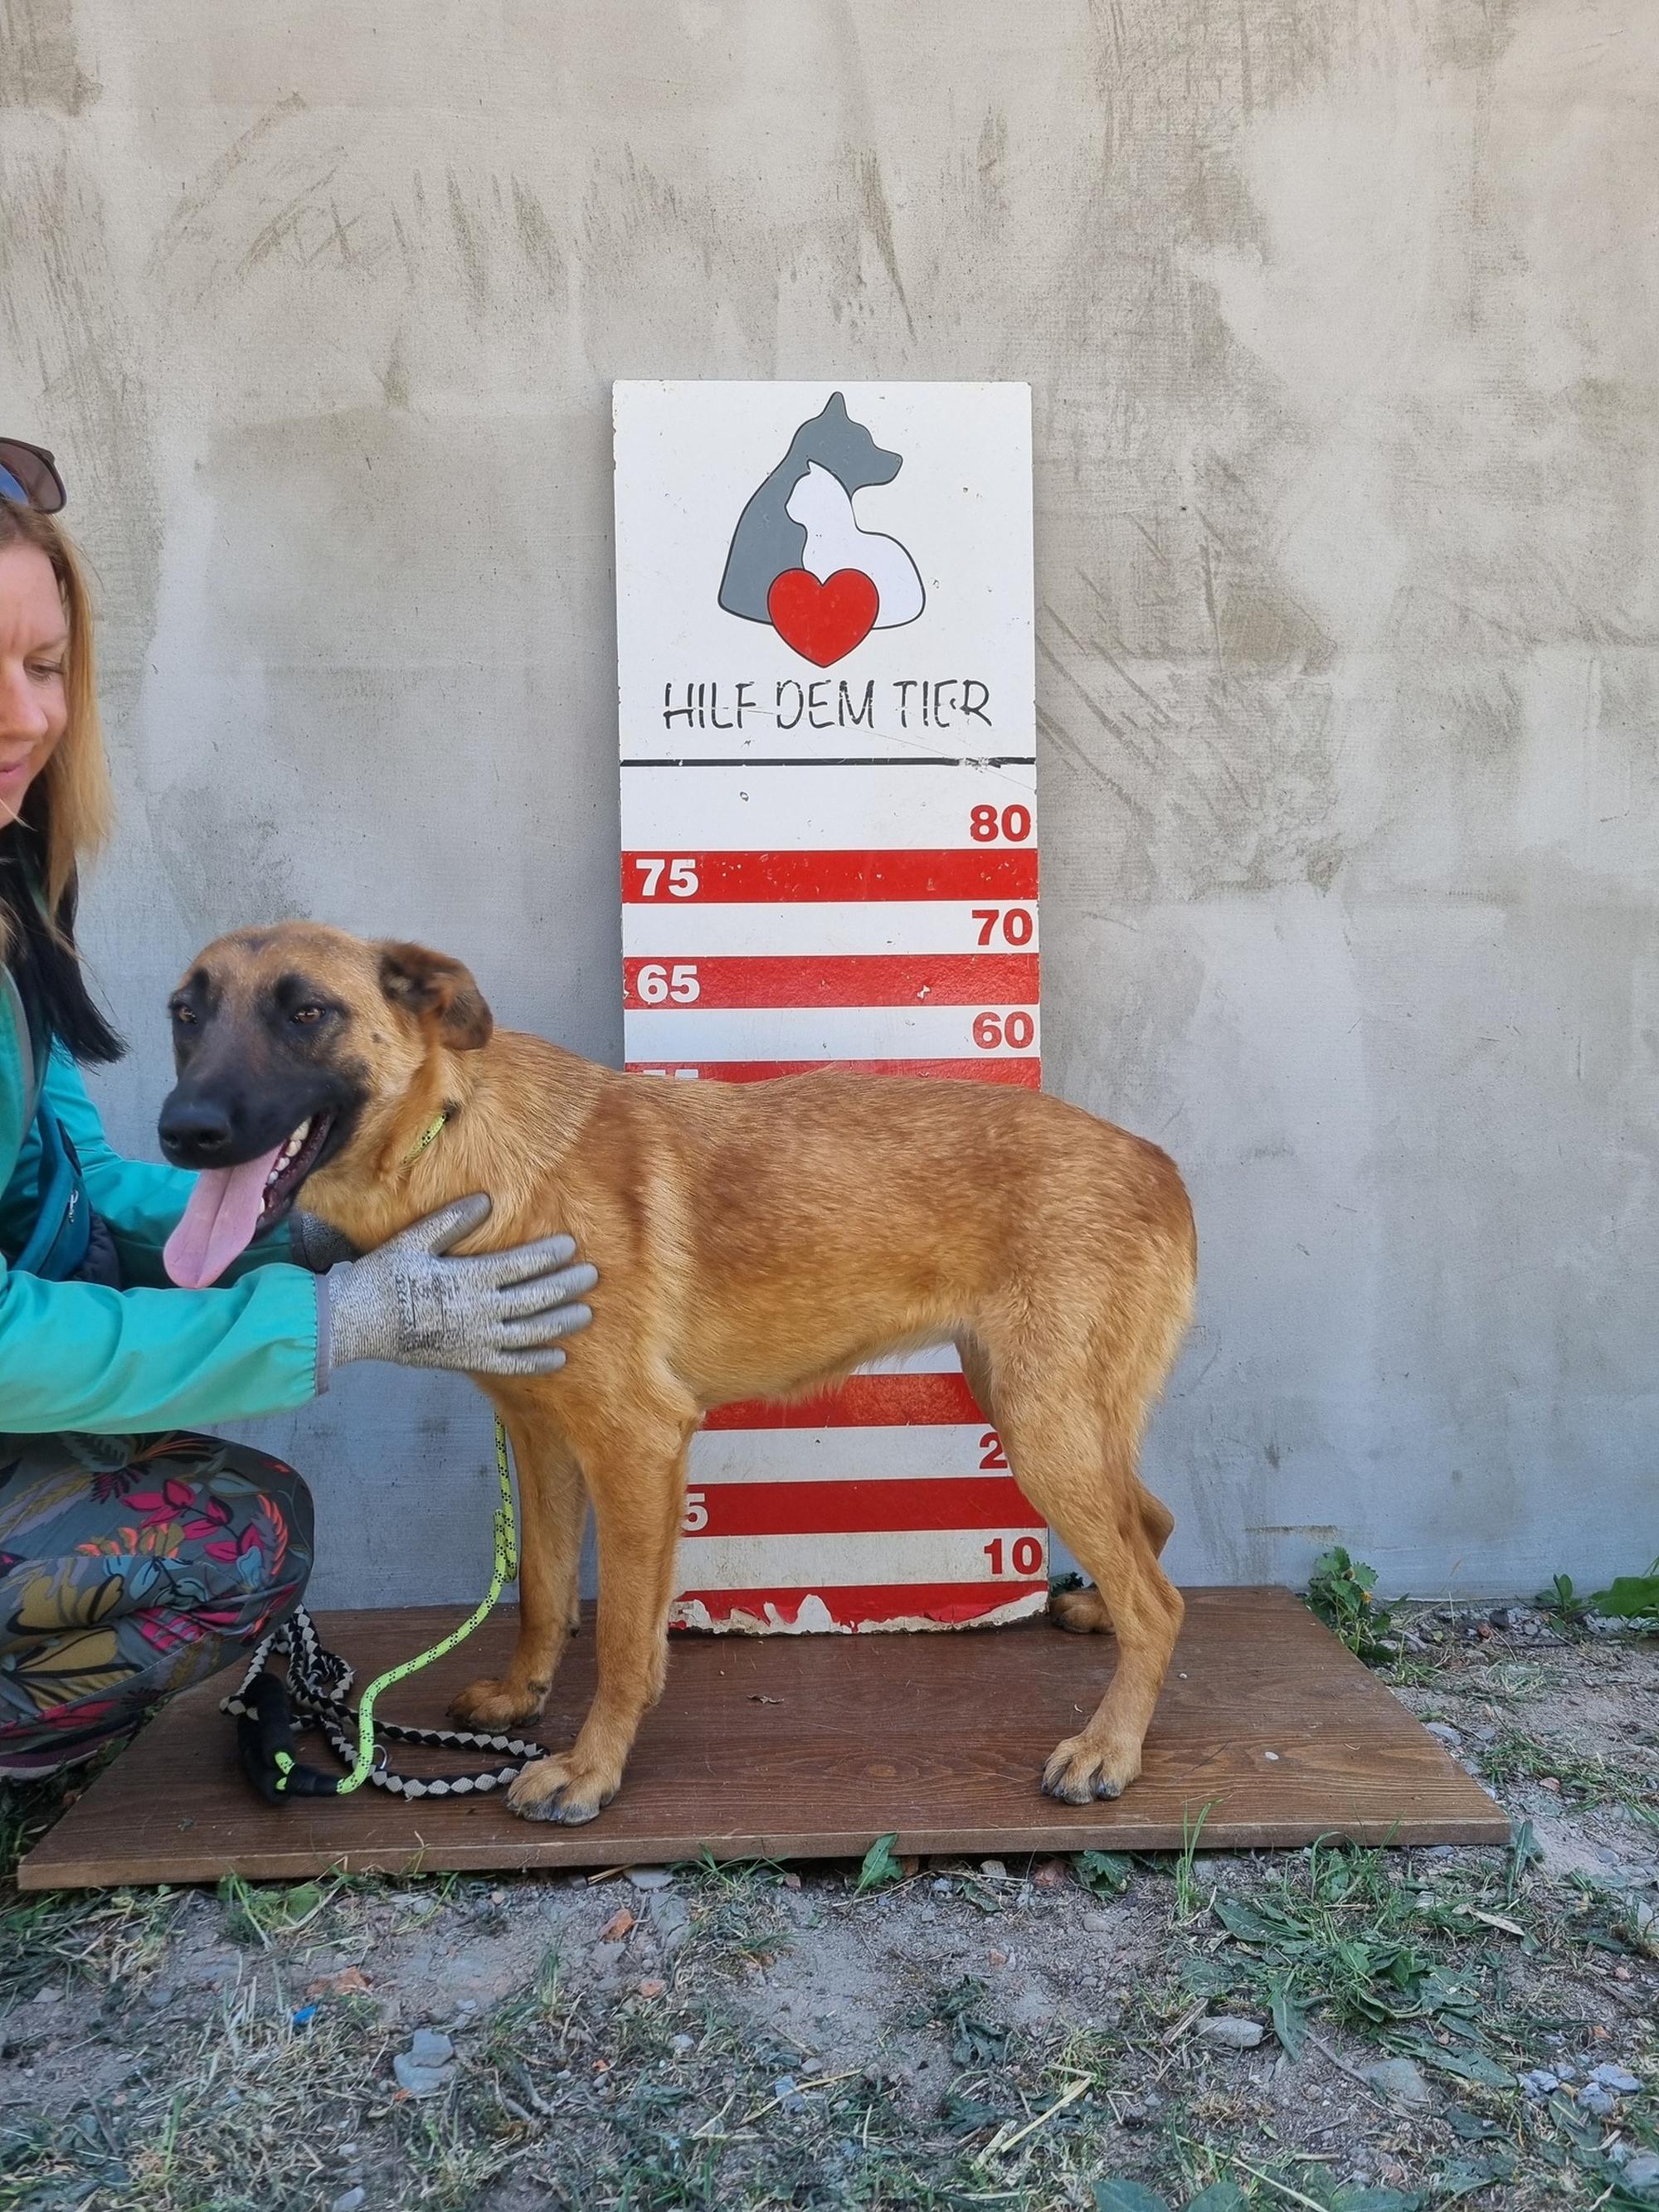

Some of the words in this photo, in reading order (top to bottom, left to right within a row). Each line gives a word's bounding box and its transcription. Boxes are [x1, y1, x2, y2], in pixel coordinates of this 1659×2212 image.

[663, 681, 757, 729] HILF
[776, 680, 875, 730] DEM
[893, 680, 992, 727] TIER
[970, 805, 1031, 843] 80
[635, 858, 698, 897] 75
[971, 908, 1033, 946] 70
[637, 965, 700, 1004] 65
[972, 1011, 1034, 1049] 60
[979, 1432, 1009, 1470] 2
[681, 1493, 709, 1531] 5
[984, 1537, 1043, 1575] 10
